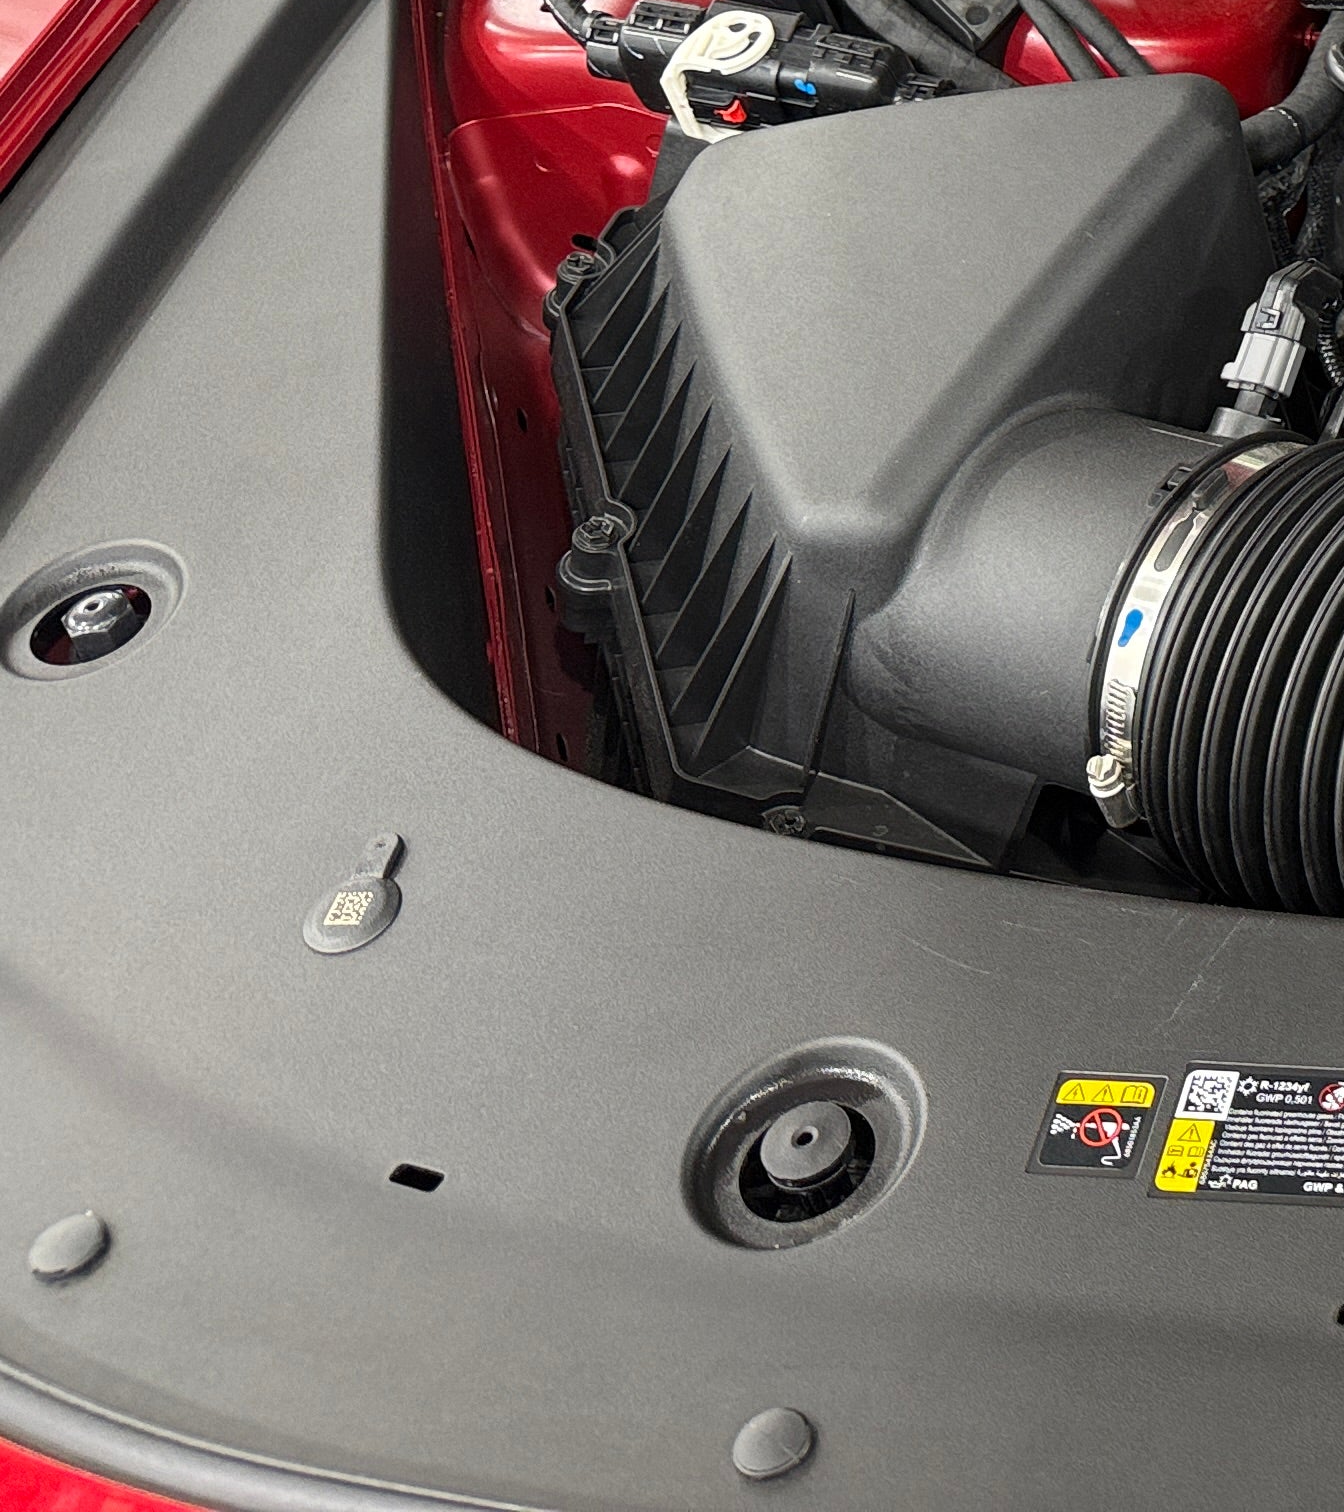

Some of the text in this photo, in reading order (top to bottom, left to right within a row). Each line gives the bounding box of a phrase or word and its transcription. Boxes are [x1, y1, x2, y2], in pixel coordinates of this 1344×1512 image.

[1259, 1080, 1310, 1093] R-1234yf
[1256, 1093, 1284, 1104] GWP
[1232, 1180, 1258, 1191] PAG
[1303, 1182, 1333, 1193] GWP
[1335, 1183, 1344, 1193] &
